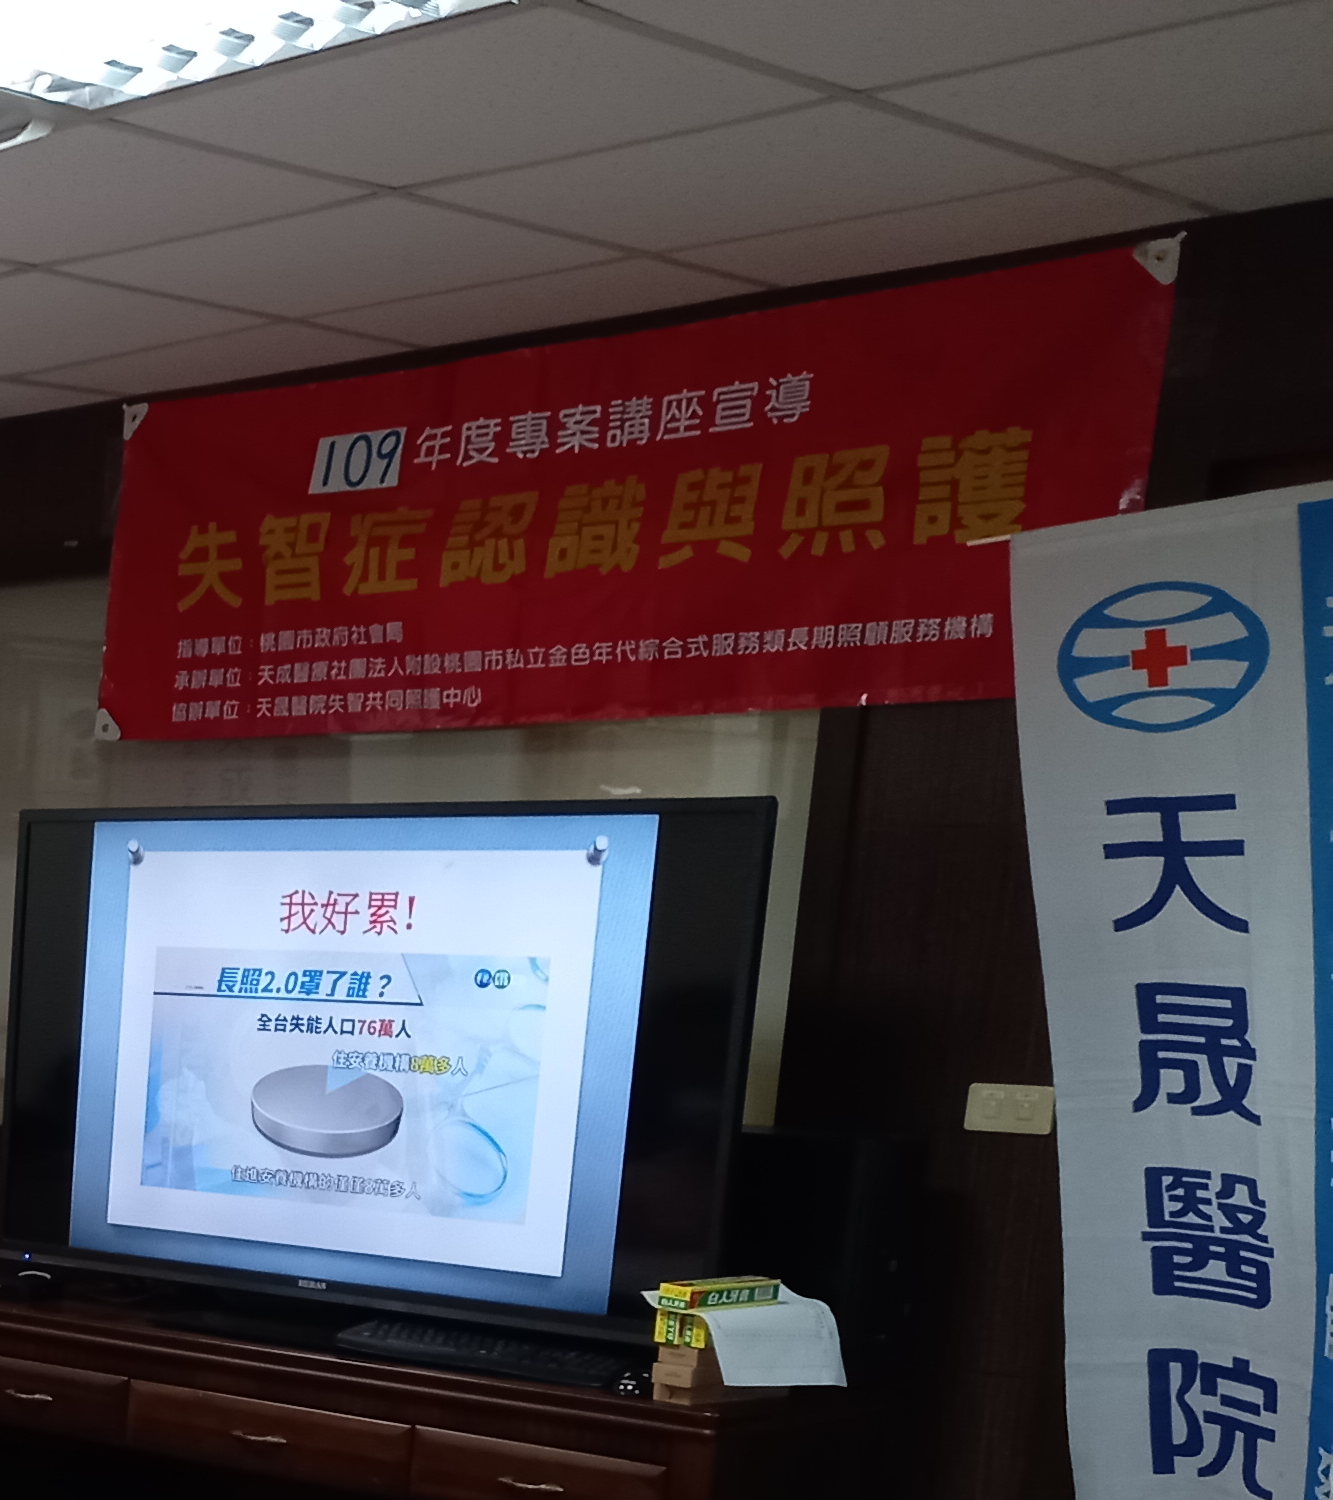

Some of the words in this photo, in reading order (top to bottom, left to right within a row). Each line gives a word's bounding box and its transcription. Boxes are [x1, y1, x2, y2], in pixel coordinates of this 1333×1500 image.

[178, 427, 1034, 613] 失智症認識與照護
[255, 1012, 412, 1040] 全台失能人口76萬人
